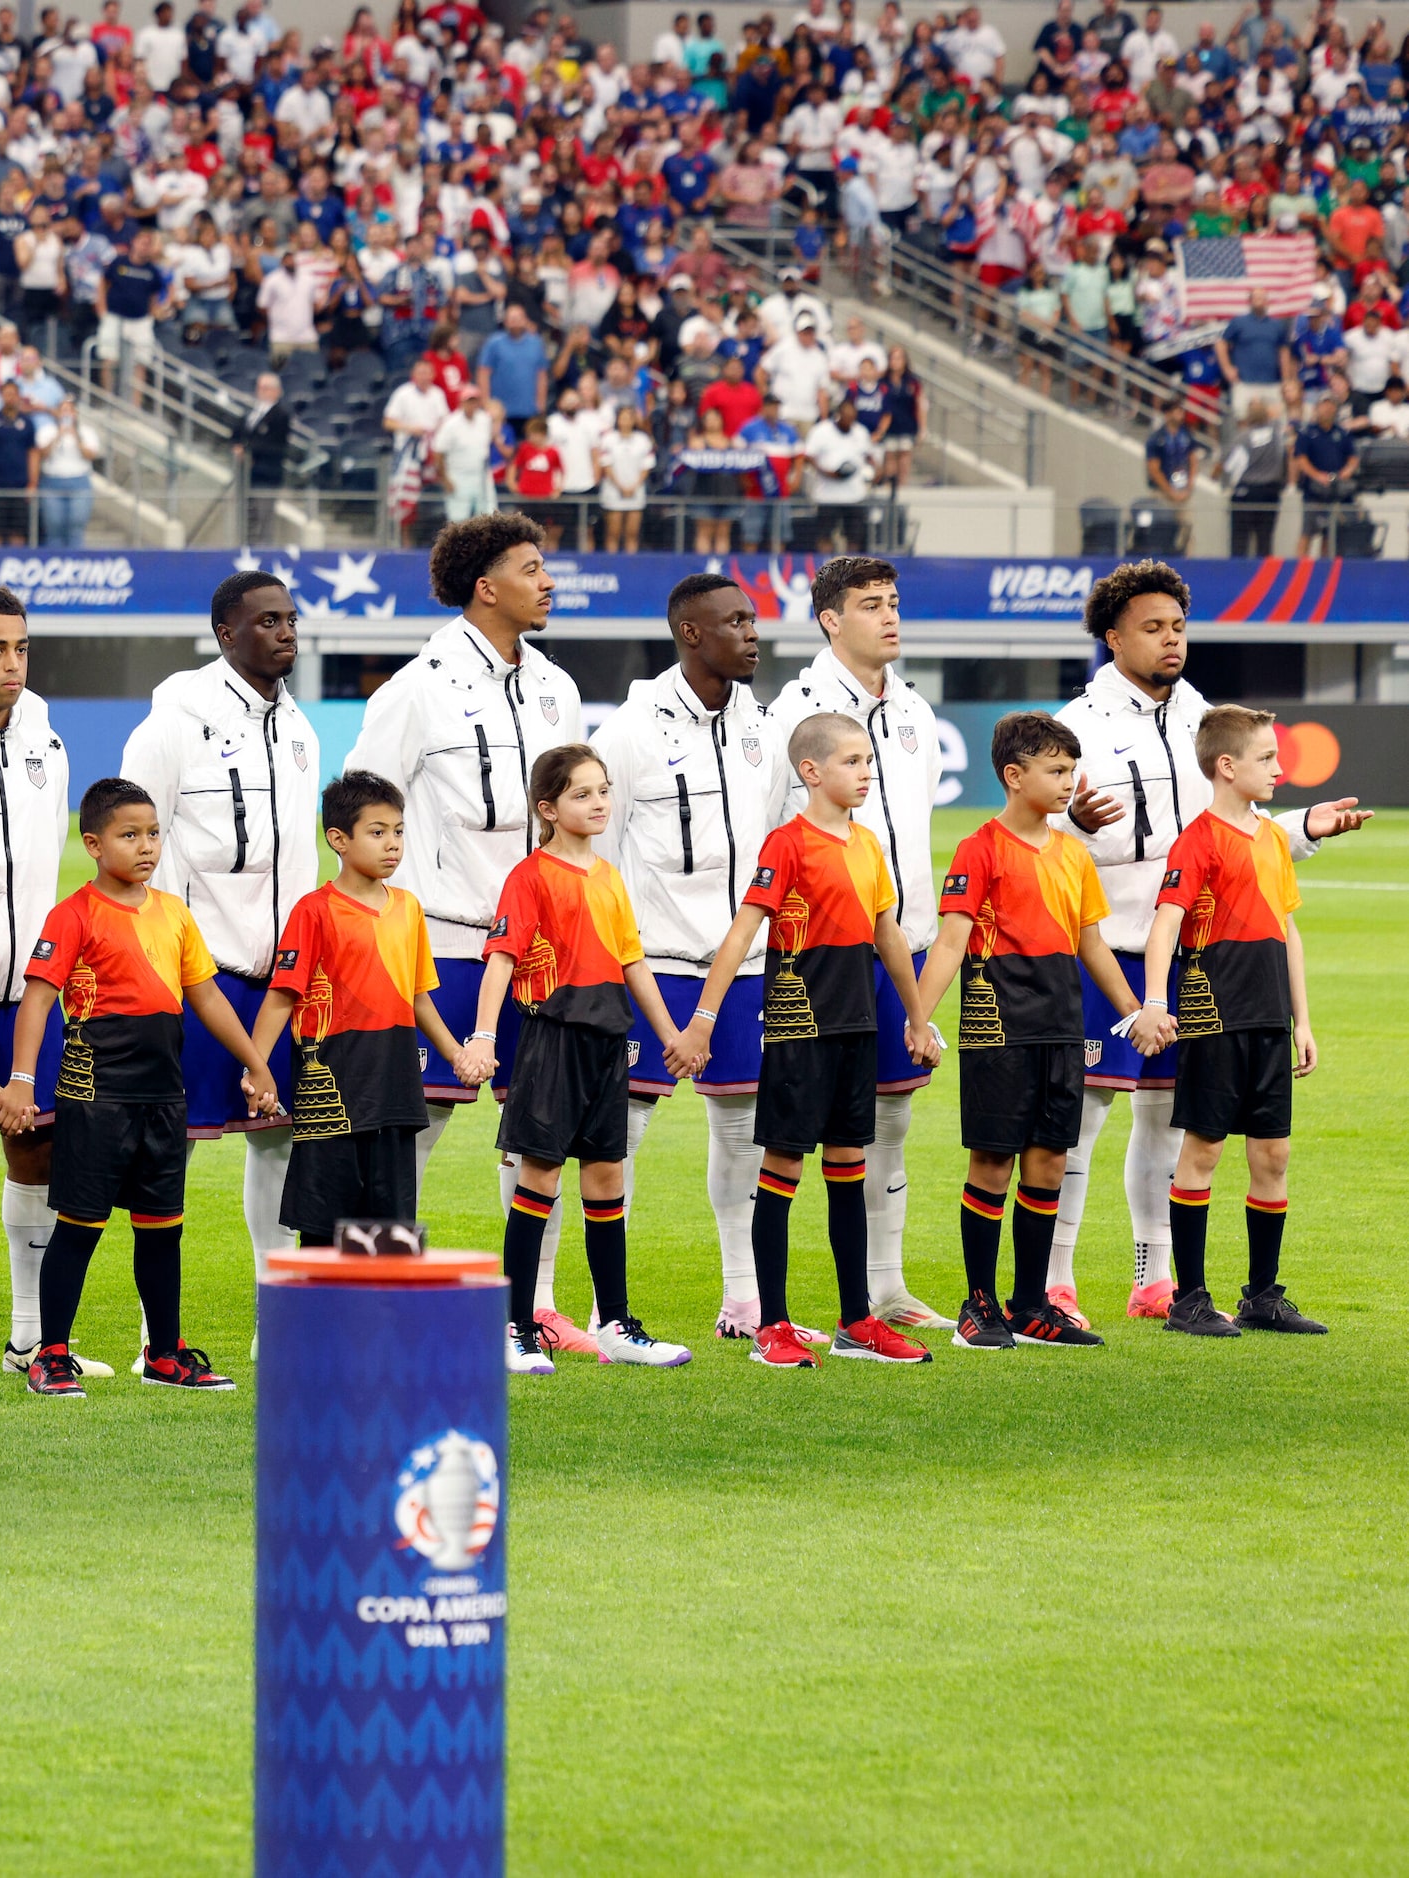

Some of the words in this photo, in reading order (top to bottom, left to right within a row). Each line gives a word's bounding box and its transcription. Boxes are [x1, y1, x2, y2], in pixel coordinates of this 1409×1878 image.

[553, 573, 620, 594] MERICA
[989, 565, 1093, 599] VIBRA
[34, 586, 134, 606] CONTINENT
[900, 727, 914, 739] USA
[744, 739, 759, 751] USA
[28, 760, 42, 773] USA
[357, 1595, 431, 1623] COPA
[405, 1623, 448, 1648] USA
